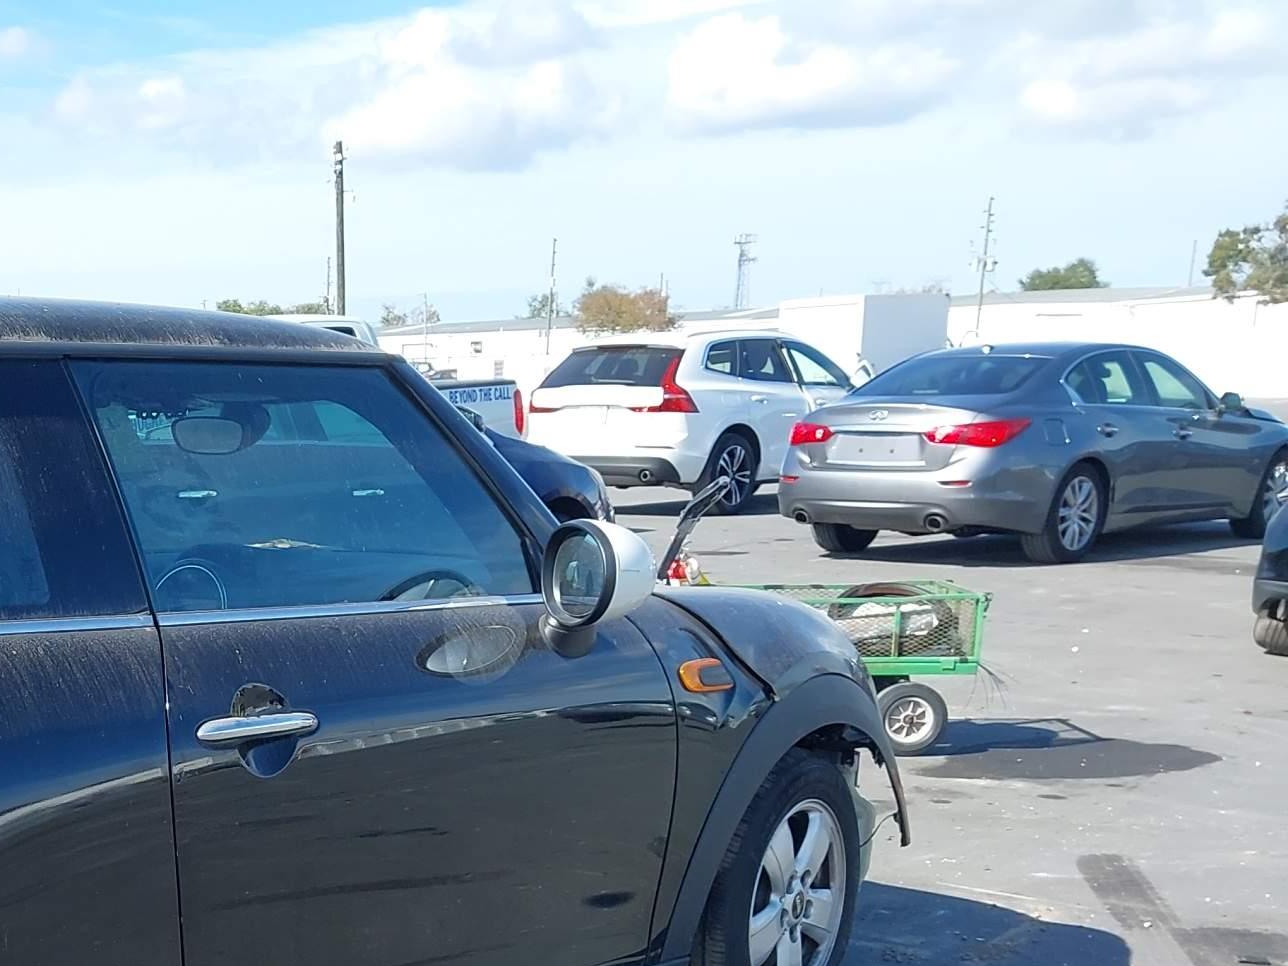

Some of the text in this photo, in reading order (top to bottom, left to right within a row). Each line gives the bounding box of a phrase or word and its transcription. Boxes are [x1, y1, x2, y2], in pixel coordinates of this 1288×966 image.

[449, 386, 512, 404] BEYOND THE CALL
